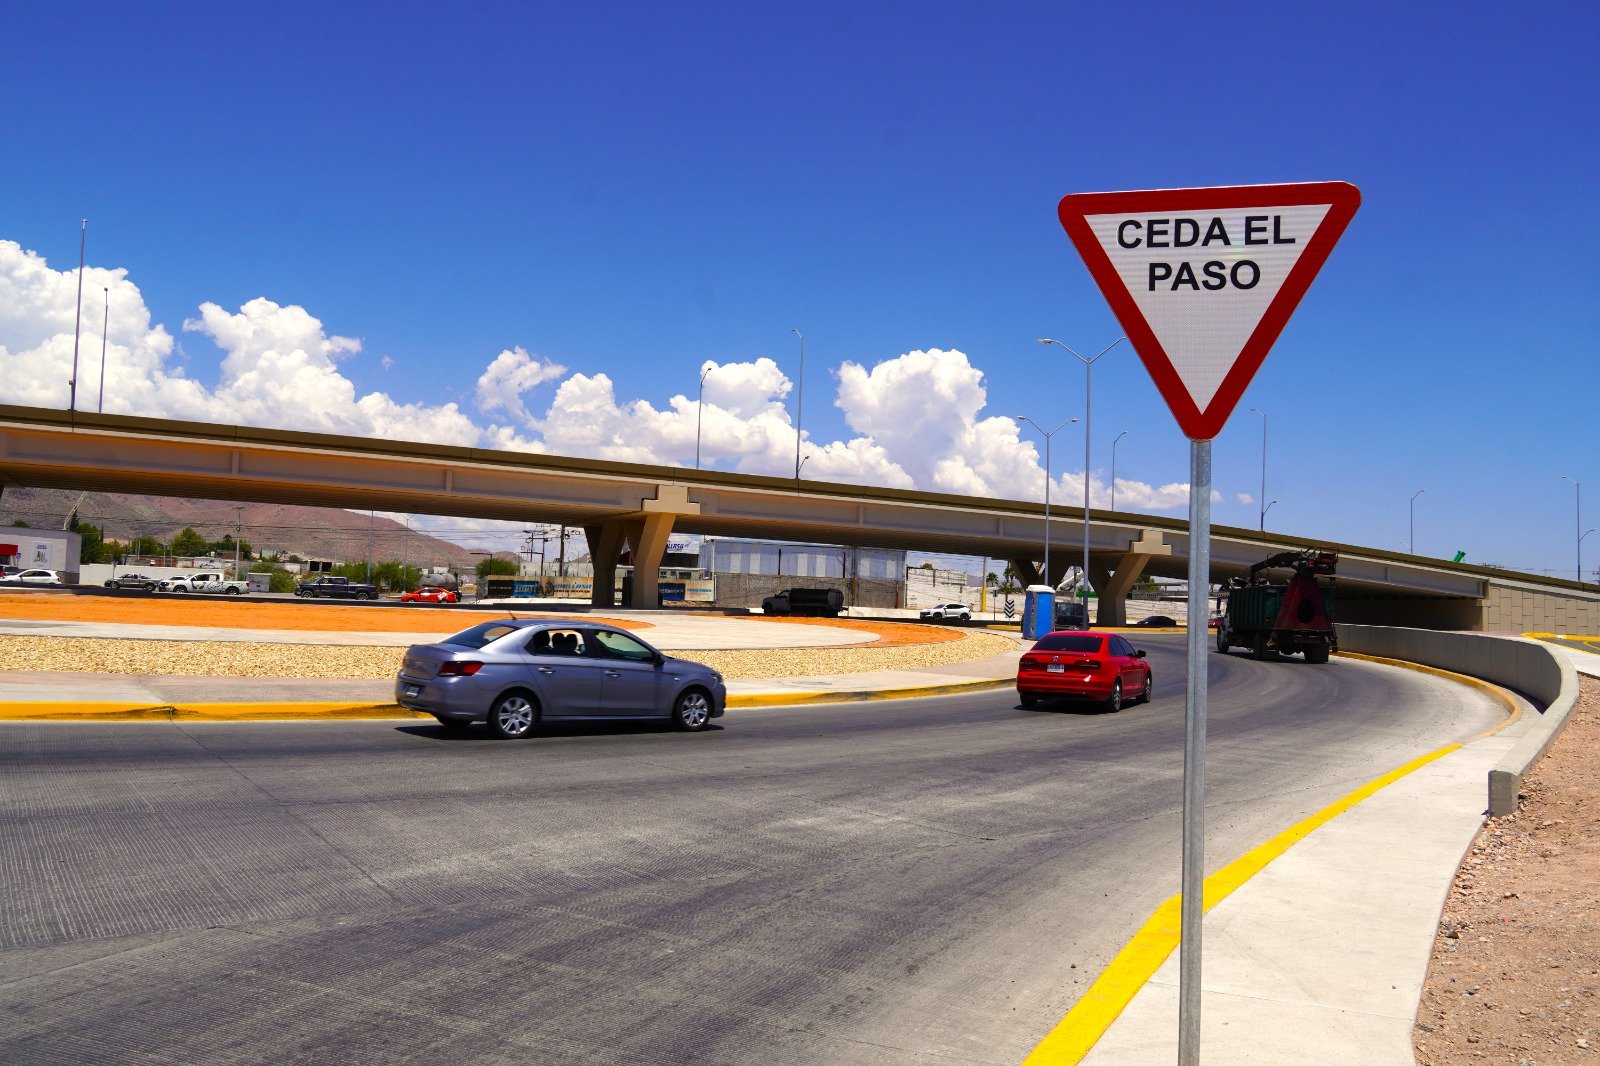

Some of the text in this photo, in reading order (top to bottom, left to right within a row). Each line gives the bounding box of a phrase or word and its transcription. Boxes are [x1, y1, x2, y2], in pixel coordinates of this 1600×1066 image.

[1117, 215, 1296, 249] CEDA EL
[1148, 260, 1261, 292] PASO
